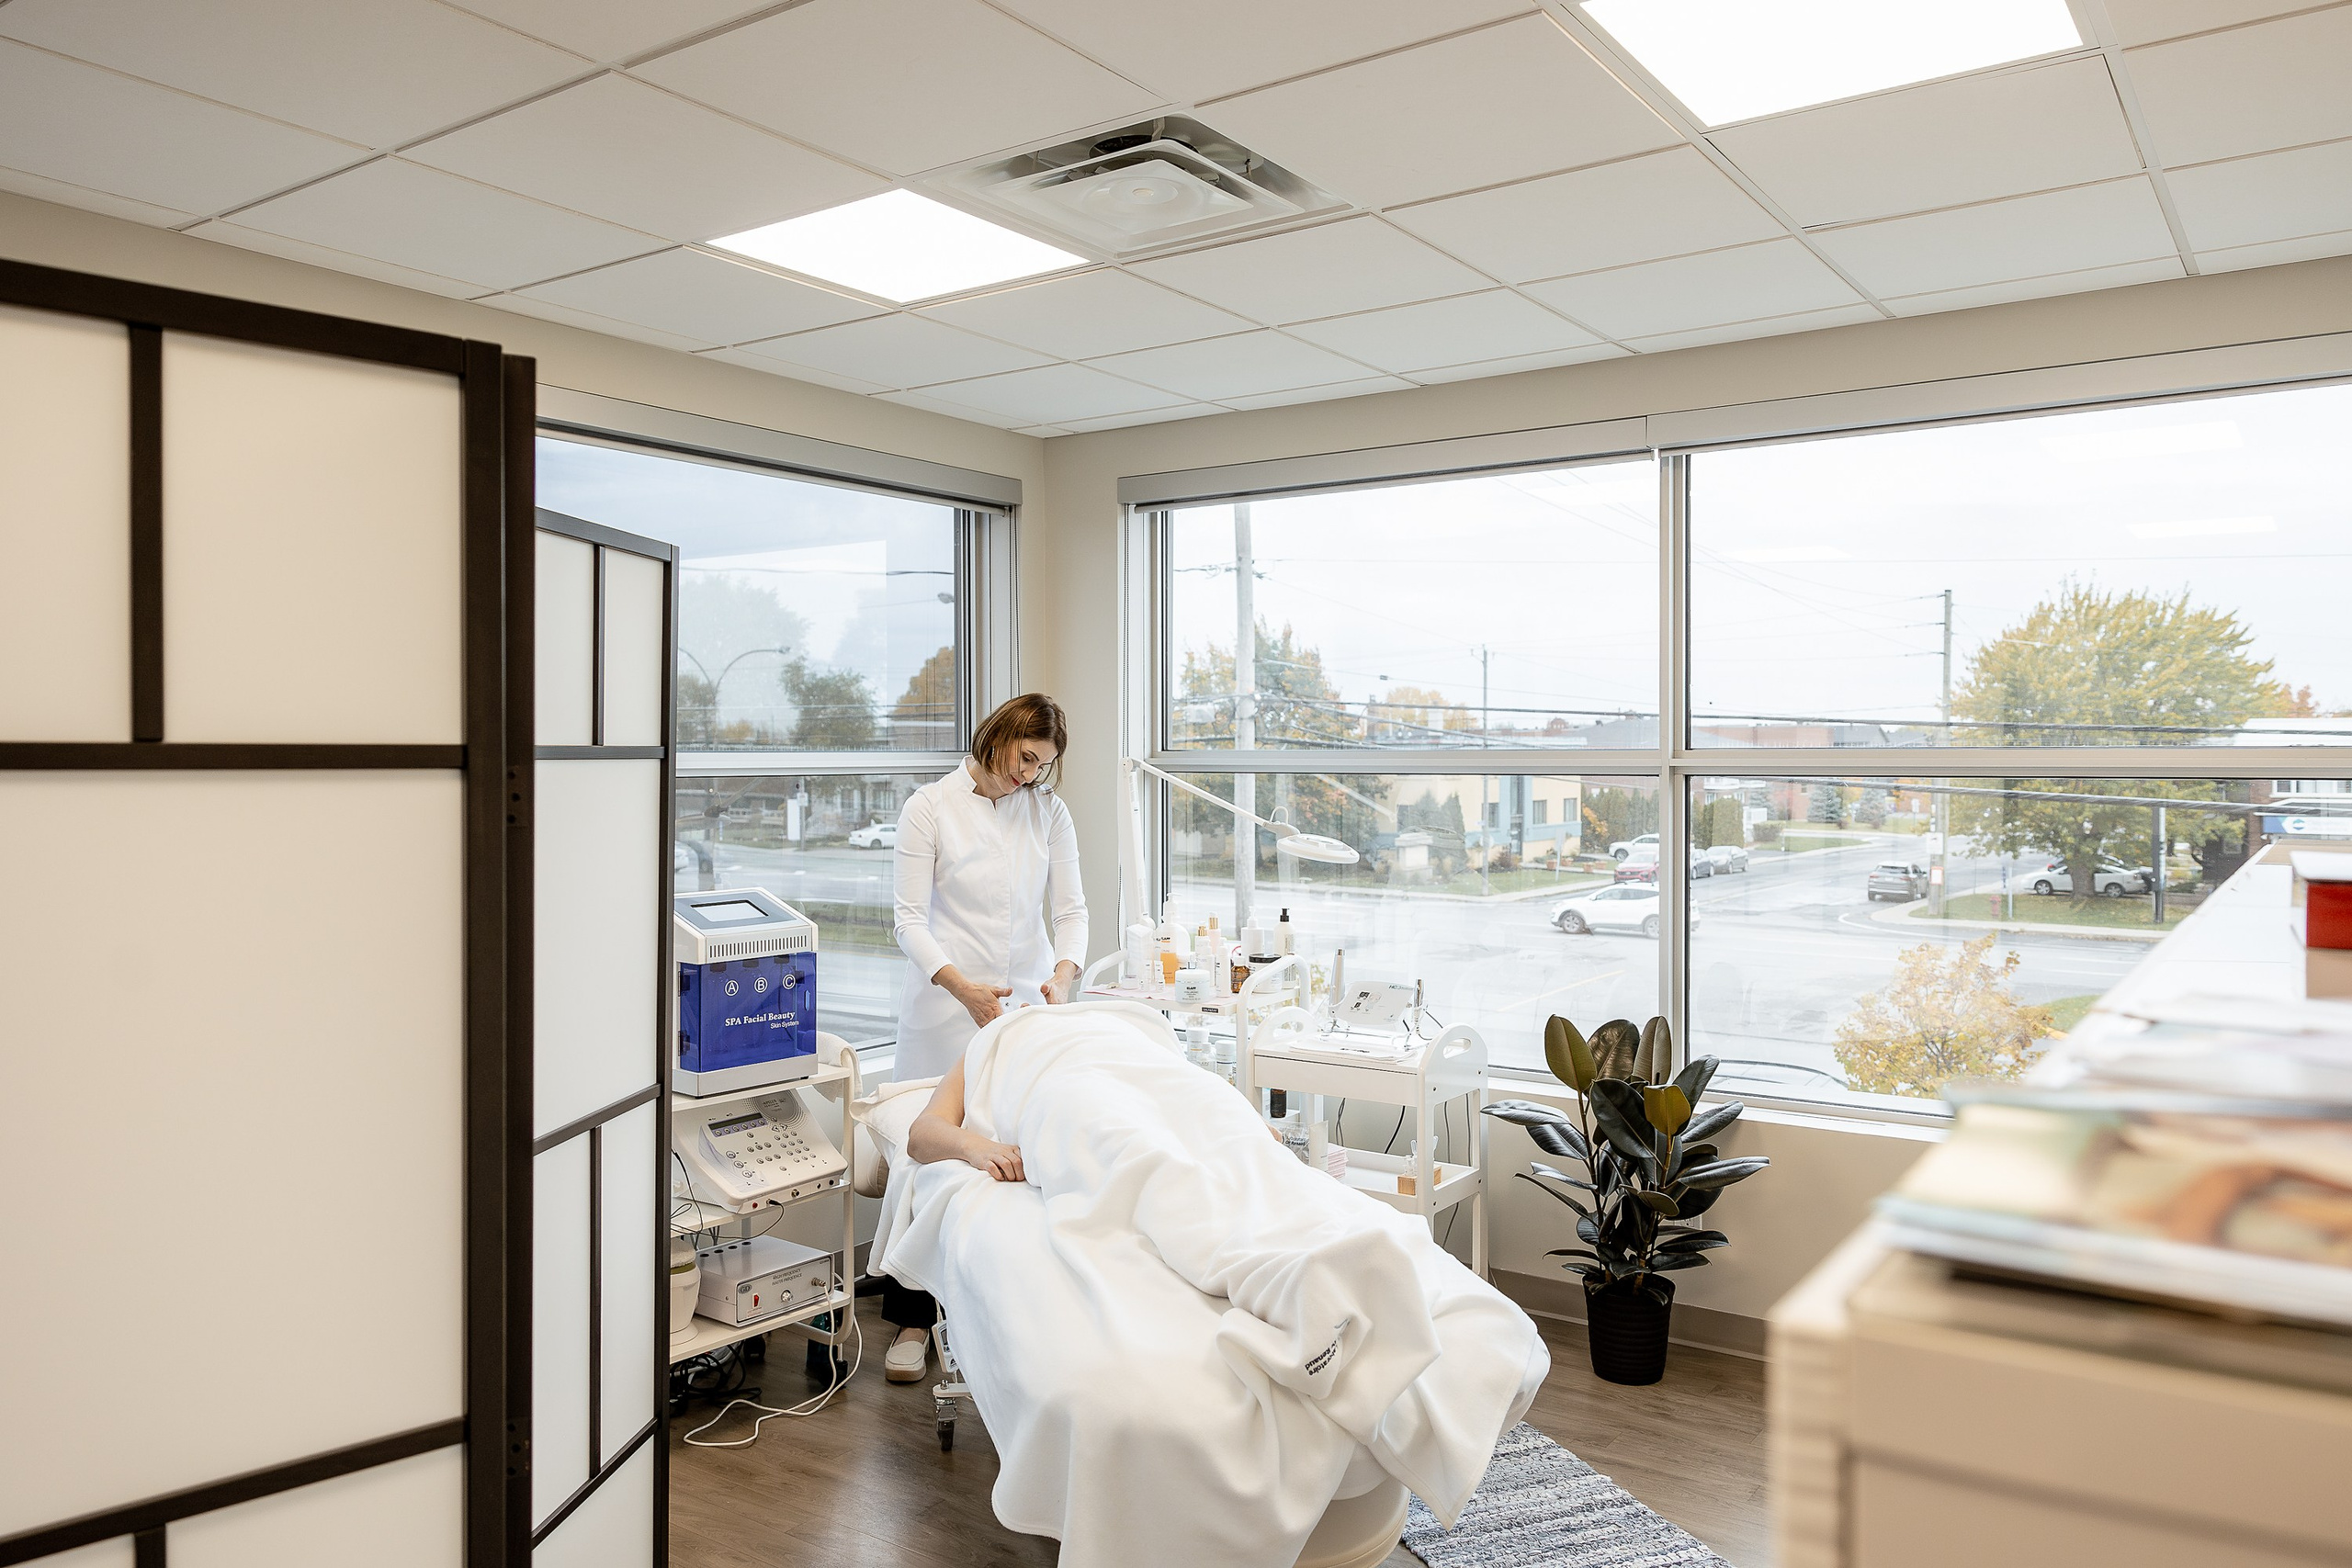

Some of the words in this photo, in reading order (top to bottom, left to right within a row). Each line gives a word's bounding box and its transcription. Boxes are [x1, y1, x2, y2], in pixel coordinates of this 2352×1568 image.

[727, 981, 738, 994] A
[756, 979, 766, 991] B
[784, 976, 794, 988] C
[725, 1018, 741, 1027] SPA
[743, 1014, 766, 1024] Facial
[768, 1011, 796, 1021] Beauty
[1305, 1348, 1330, 1371] Renaud
